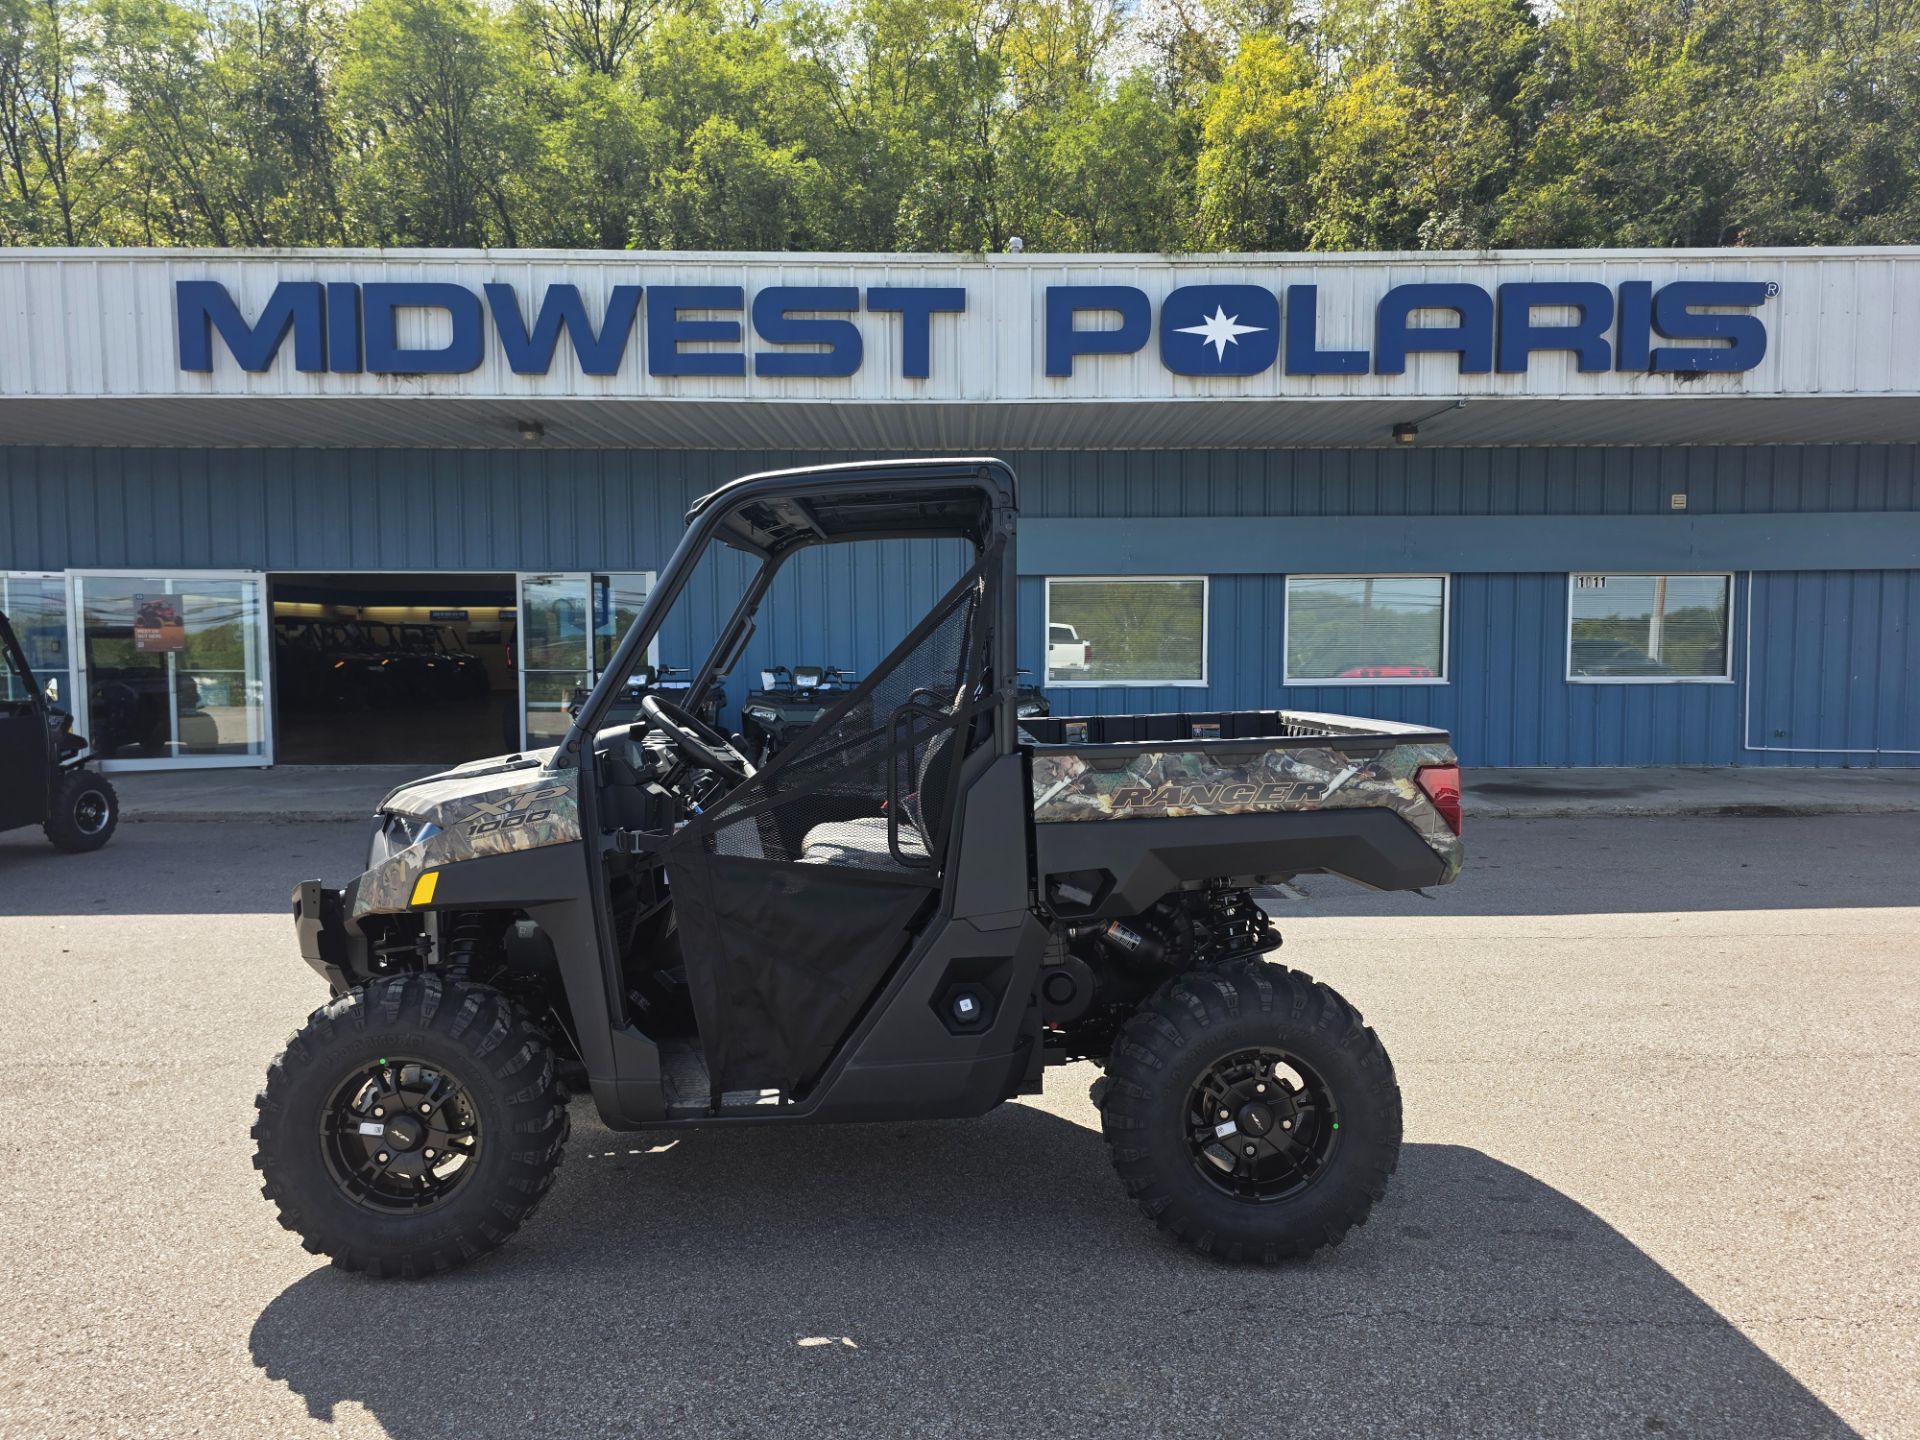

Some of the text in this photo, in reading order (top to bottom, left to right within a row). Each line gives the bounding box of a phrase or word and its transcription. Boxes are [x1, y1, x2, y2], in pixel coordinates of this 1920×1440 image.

[175, 280, 967, 379] MIDWEST
[1578, 576, 1606, 588] 1011
[454, 785, 571, 824] XP
[1110, 782, 1330, 809] RANGER
[467, 809, 552, 835] 1000
